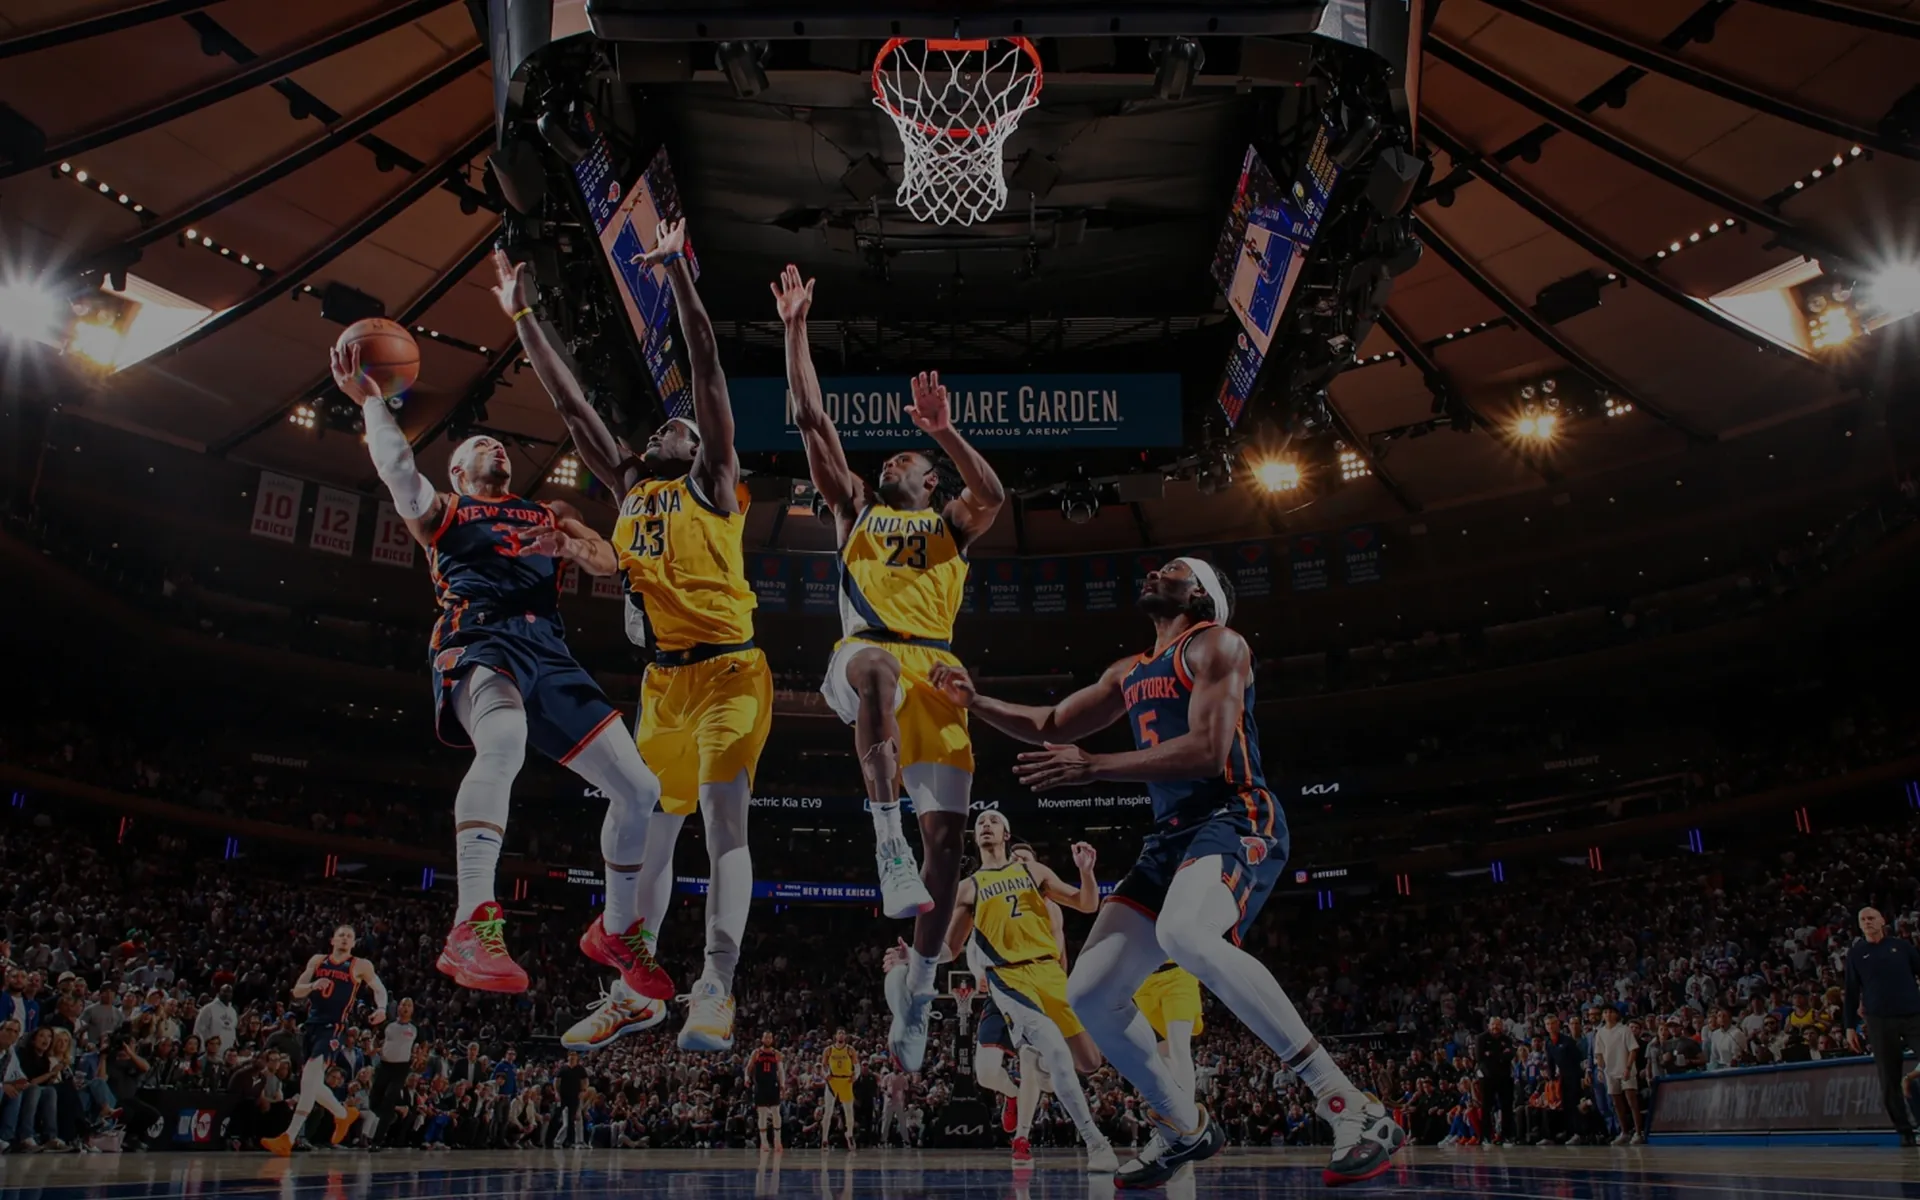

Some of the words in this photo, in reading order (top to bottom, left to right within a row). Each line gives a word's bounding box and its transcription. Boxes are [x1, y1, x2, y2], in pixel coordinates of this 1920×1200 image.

[785, 388, 900, 425] DISON
[947, 390, 1009, 424] UARE
[865, 429, 922, 437] WORLD'S
[969, 427, 1021, 436] FAMOUS
[262, 491, 292, 521] 10
[456, 504, 500, 526] NEW
[502, 506, 550, 528] YORK
[254, 518, 294, 538] KNICKS
[320, 505, 350, 536] 12
[867, 516, 944, 539] INDIANA
[313, 533, 352, 552] KNICKS
[380, 520, 410, 548] 15
[491, 522, 523, 558] 3
[629, 520, 665, 557] 43
[374, 546, 413, 564] KNICKS
[886, 535, 926, 569] 23
[594, 582, 622, 595] KNICK
[756, 580, 787, 590] 1969-70
[805, 582, 836, 592] 1972-73
[989, 584, 1020, 593] 1970-71
[1034, 584, 1065, 593] 1971-72
[1124, 681, 1141, 711] EW
[1141, 676, 1180, 700] YORK
[1138, 709, 1160, 747] 5
[583, 787, 608, 798] KI
[1301, 782, 1340, 796] KIA
[750, 796, 779, 807] ectric
[782, 797, 799, 808] Kia
[801, 797, 822, 809] EV9
[1037, 797, 1092, 809] Movement
[1094, 796, 1115, 808] that
[1117, 794, 1151, 807] inspire
[802, 886, 820, 896] NEW
[822, 887, 843, 897] YORK
[845, 888, 876, 897] KNICKS
[979, 876, 1034, 899] INDIANA
[1006, 895, 1022, 918] 2
[1823, 1078, 1854, 1117] GET
[944, 1124, 984, 1136] KIA
